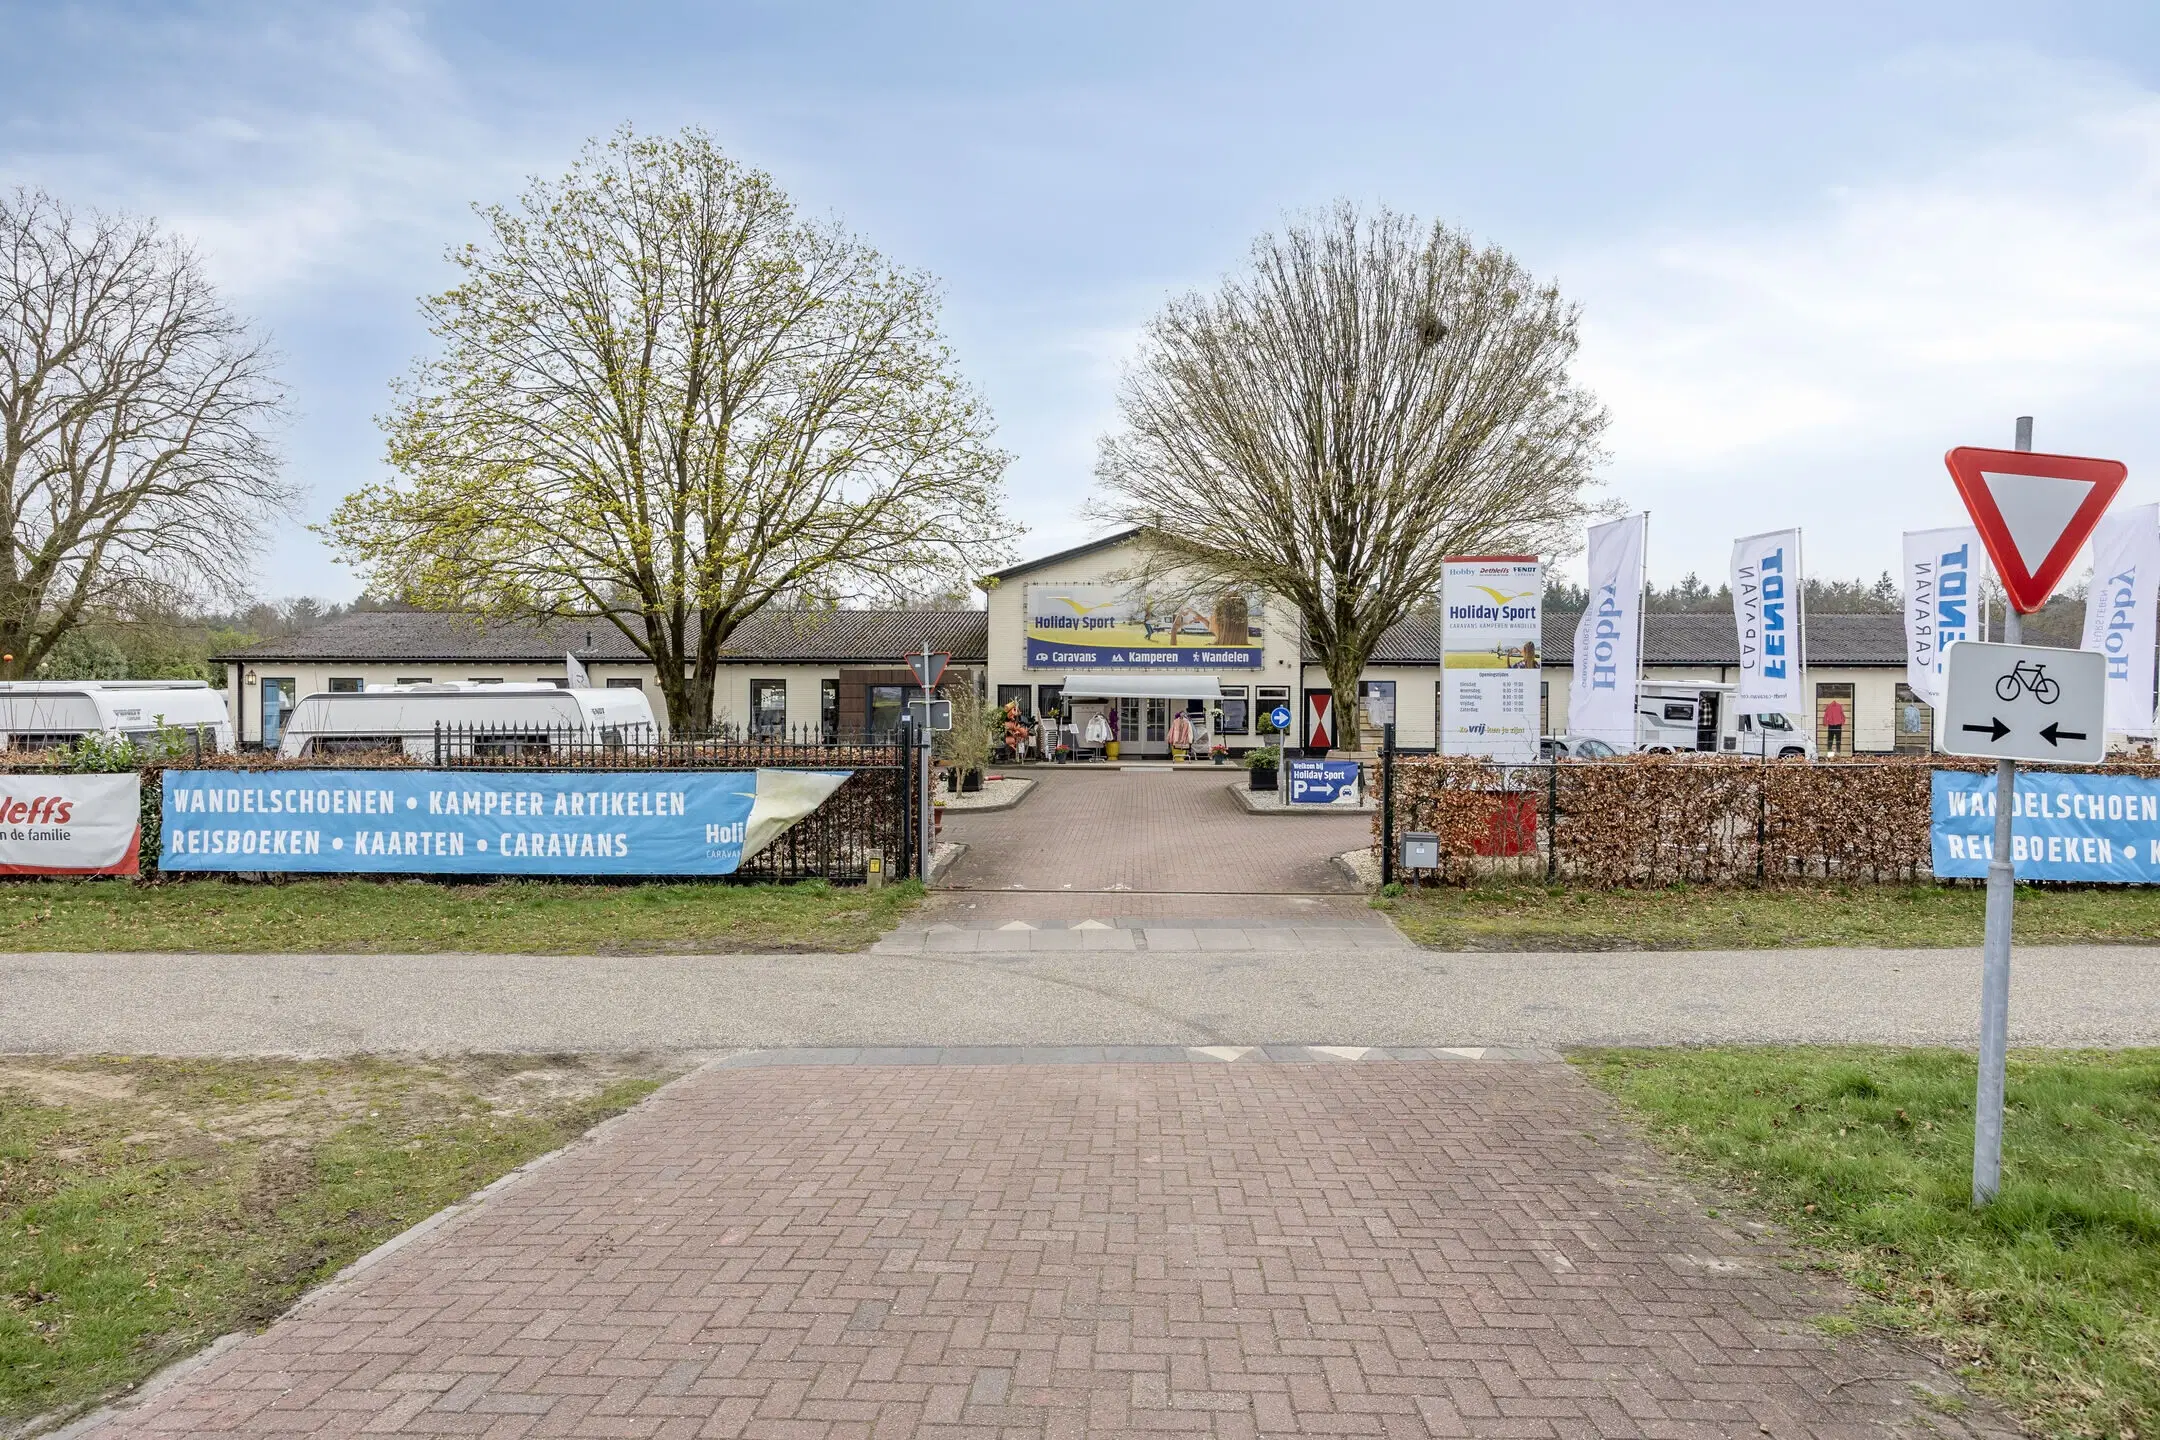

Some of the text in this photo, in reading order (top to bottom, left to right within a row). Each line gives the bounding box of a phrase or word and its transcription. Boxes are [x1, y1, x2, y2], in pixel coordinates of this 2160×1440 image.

[1449, 568, 1475, 576] Hobby
[1450, 605, 1536, 621] Holiday Sport
[1035, 616, 1115, 631] Holiday Sport
[1052, 651, 1249, 664] Caravans Kamperen Wandelen
[1469, 723, 1485, 735] vrij
[1294, 770, 1345, 781] Holiday Sport
[1293, 780, 1308, 799] P
[173, 789, 685, 816] WANDELSCHOENEN KAMPEER ARTIKELEN
[10, 828, 25, 841] de
[28, 828, 71, 841] familie
[172, 830, 628, 857] REISBOEKEN KAARTEN CARAVANS
[1948, 835, 2113, 864] REIBOEKEN
